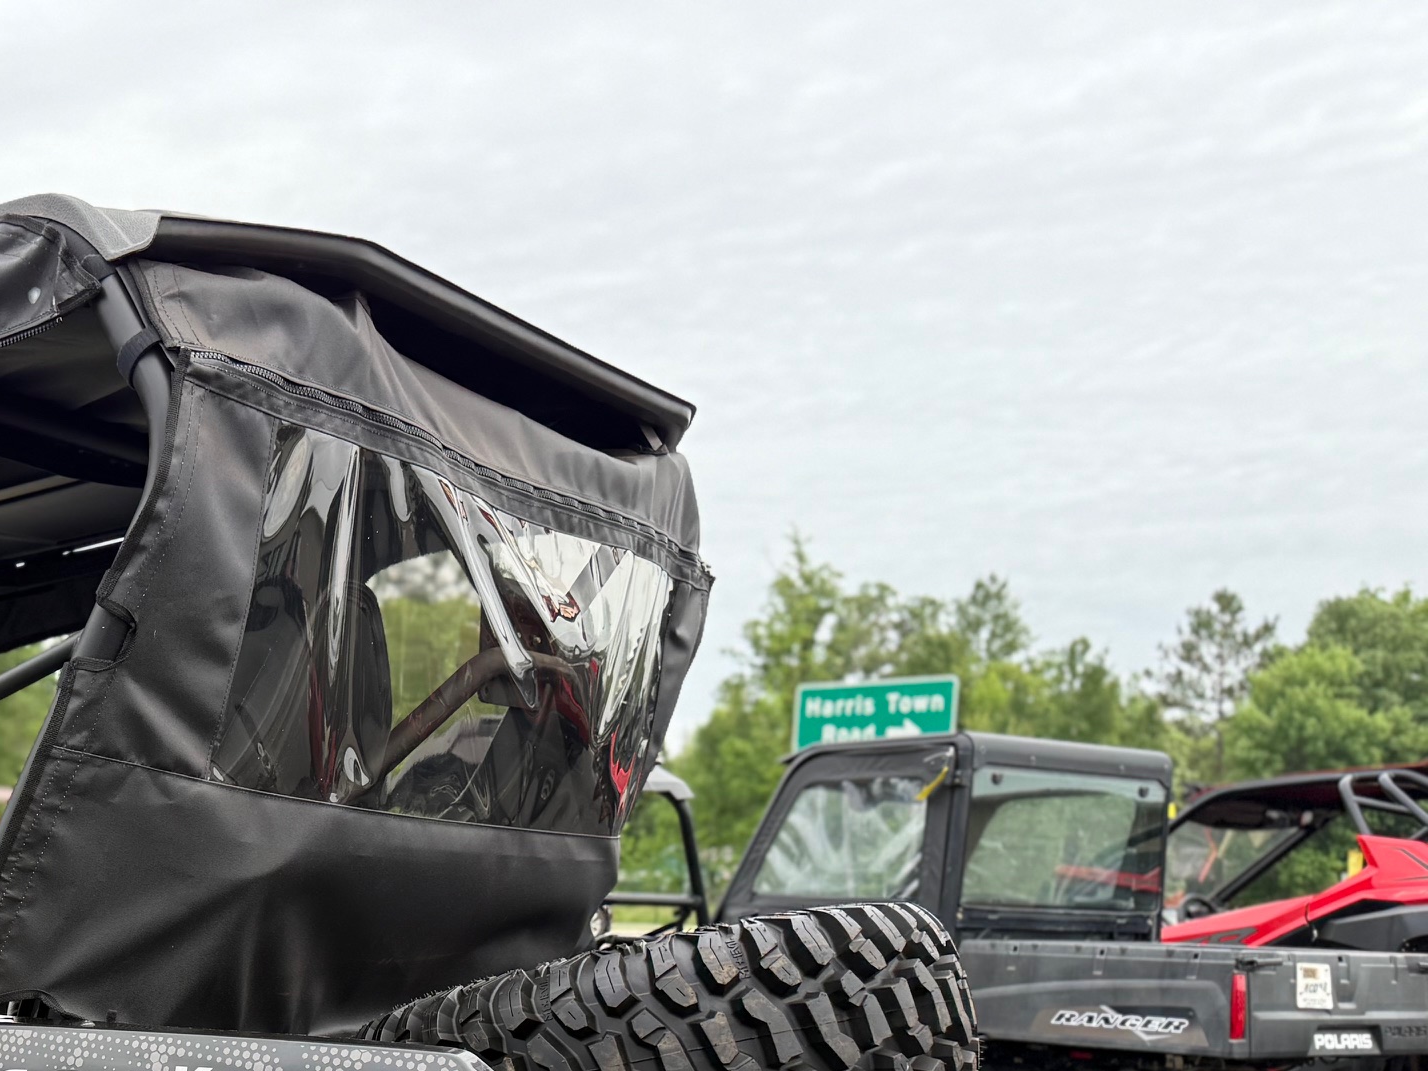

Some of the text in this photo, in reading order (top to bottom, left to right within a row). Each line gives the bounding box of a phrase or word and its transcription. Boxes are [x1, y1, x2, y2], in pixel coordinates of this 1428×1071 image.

[805, 691, 945, 718] Harris Town
[1050, 1009, 1189, 1034] RANGER
[1313, 1033, 1373, 1050] POLARIS
